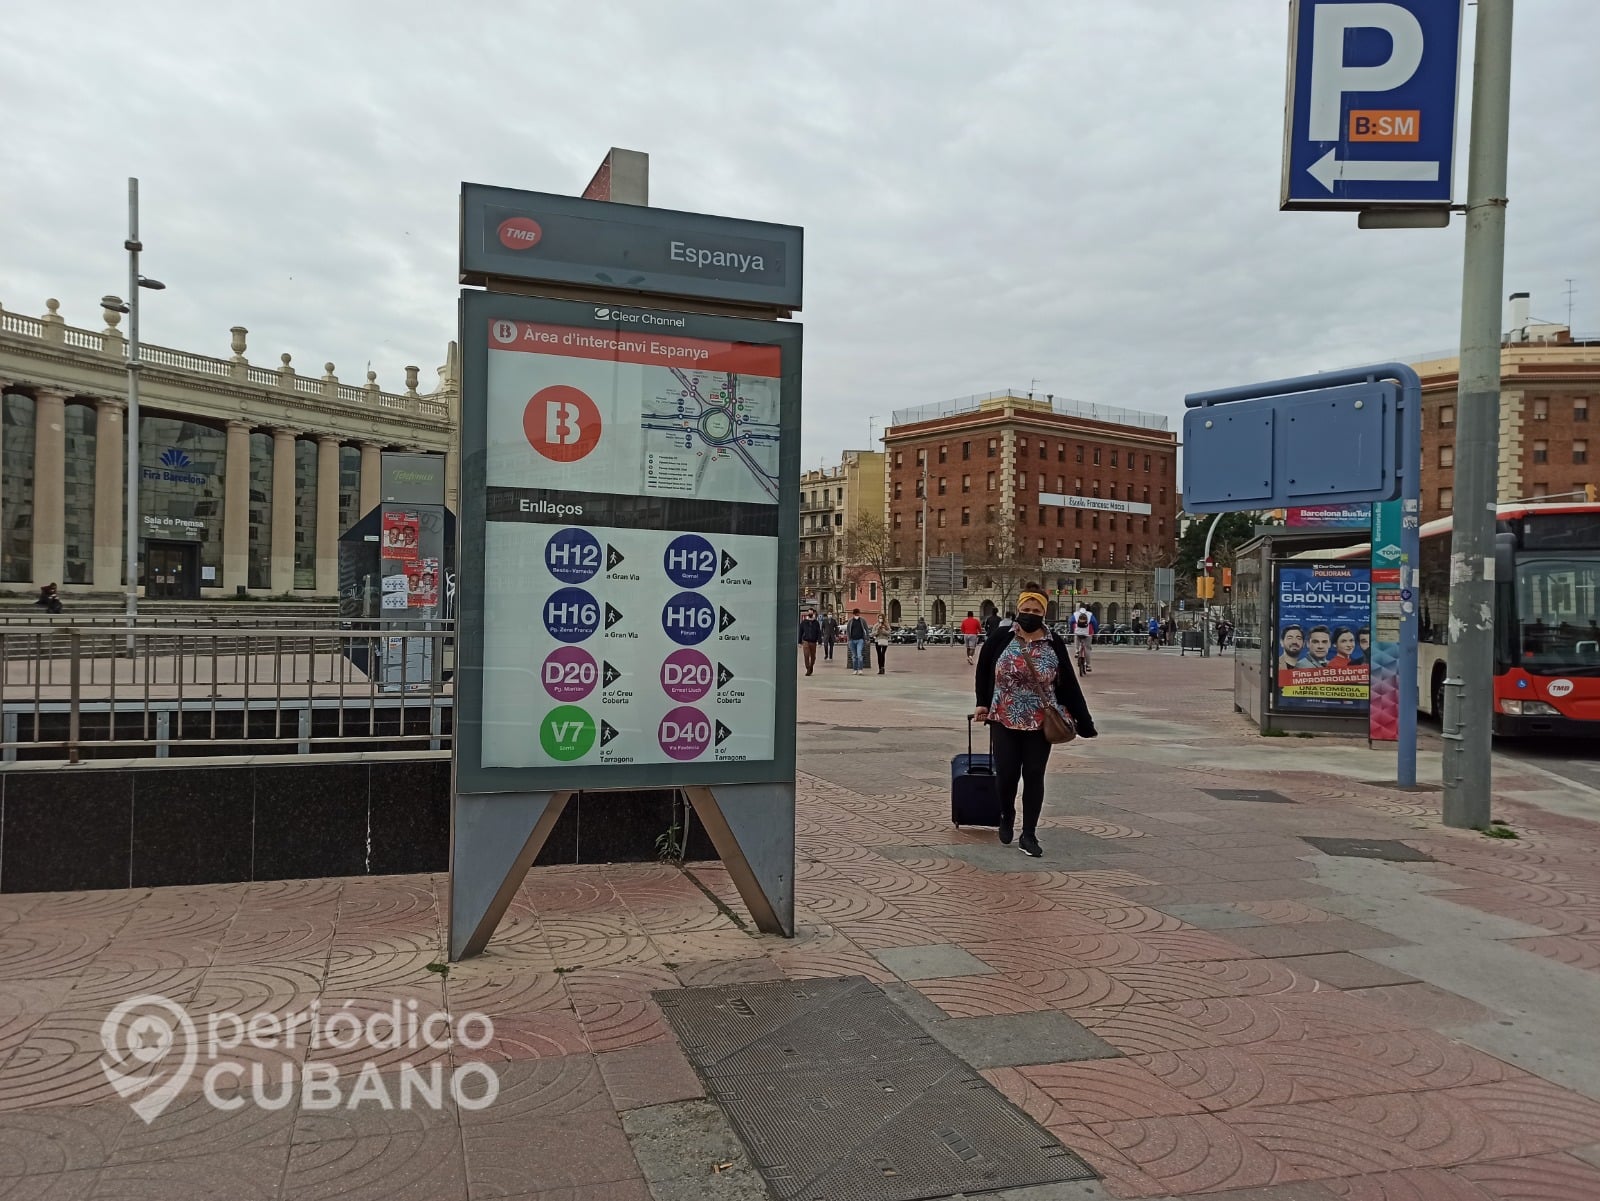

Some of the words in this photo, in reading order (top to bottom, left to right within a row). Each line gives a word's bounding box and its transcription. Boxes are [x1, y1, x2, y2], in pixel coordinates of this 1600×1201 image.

[1308, 2, 1424, 142] P
[1355, 116, 1414, 136] B:SM
[505, 227, 536, 241] TMB
[669, 241, 765, 273] Espanya
[611, 310, 639, 322] Clear
[641, 313, 685, 327] Channel
[523, 325, 558, 343] Àrea
[562, 333, 647, 353] d'intercanvi
[650, 342, 709, 360] Espanya
[143, 469, 161, 480] Fira
[163, 471, 206, 485] Barcelona
[519, 499, 583, 517] Enllaços
[1300, 509, 1341, 517] Barcelona
[144, 515, 162, 525] Sala
[163, 517, 174, 526] de
[174, 518, 204, 528] Premsa
[550, 543, 599, 566] H12
[668, 549, 714, 572] H12
[629, 573, 640, 581] Via
[1281, 581, 1302, 592] EL
[1305, 579, 1370, 592] MÈTOD
[548, 602, 597, 625] H16
[666, 606, 712, 629] H16
[610, 631, 627, 639] Gran
[545, 661, 596, 684] D20
[664, 663, 711, 685] D20
[550, 721, 585, 743] V7
[661, 721, 710, 743] D40
[600, 756, 634, 764] Tarragona
